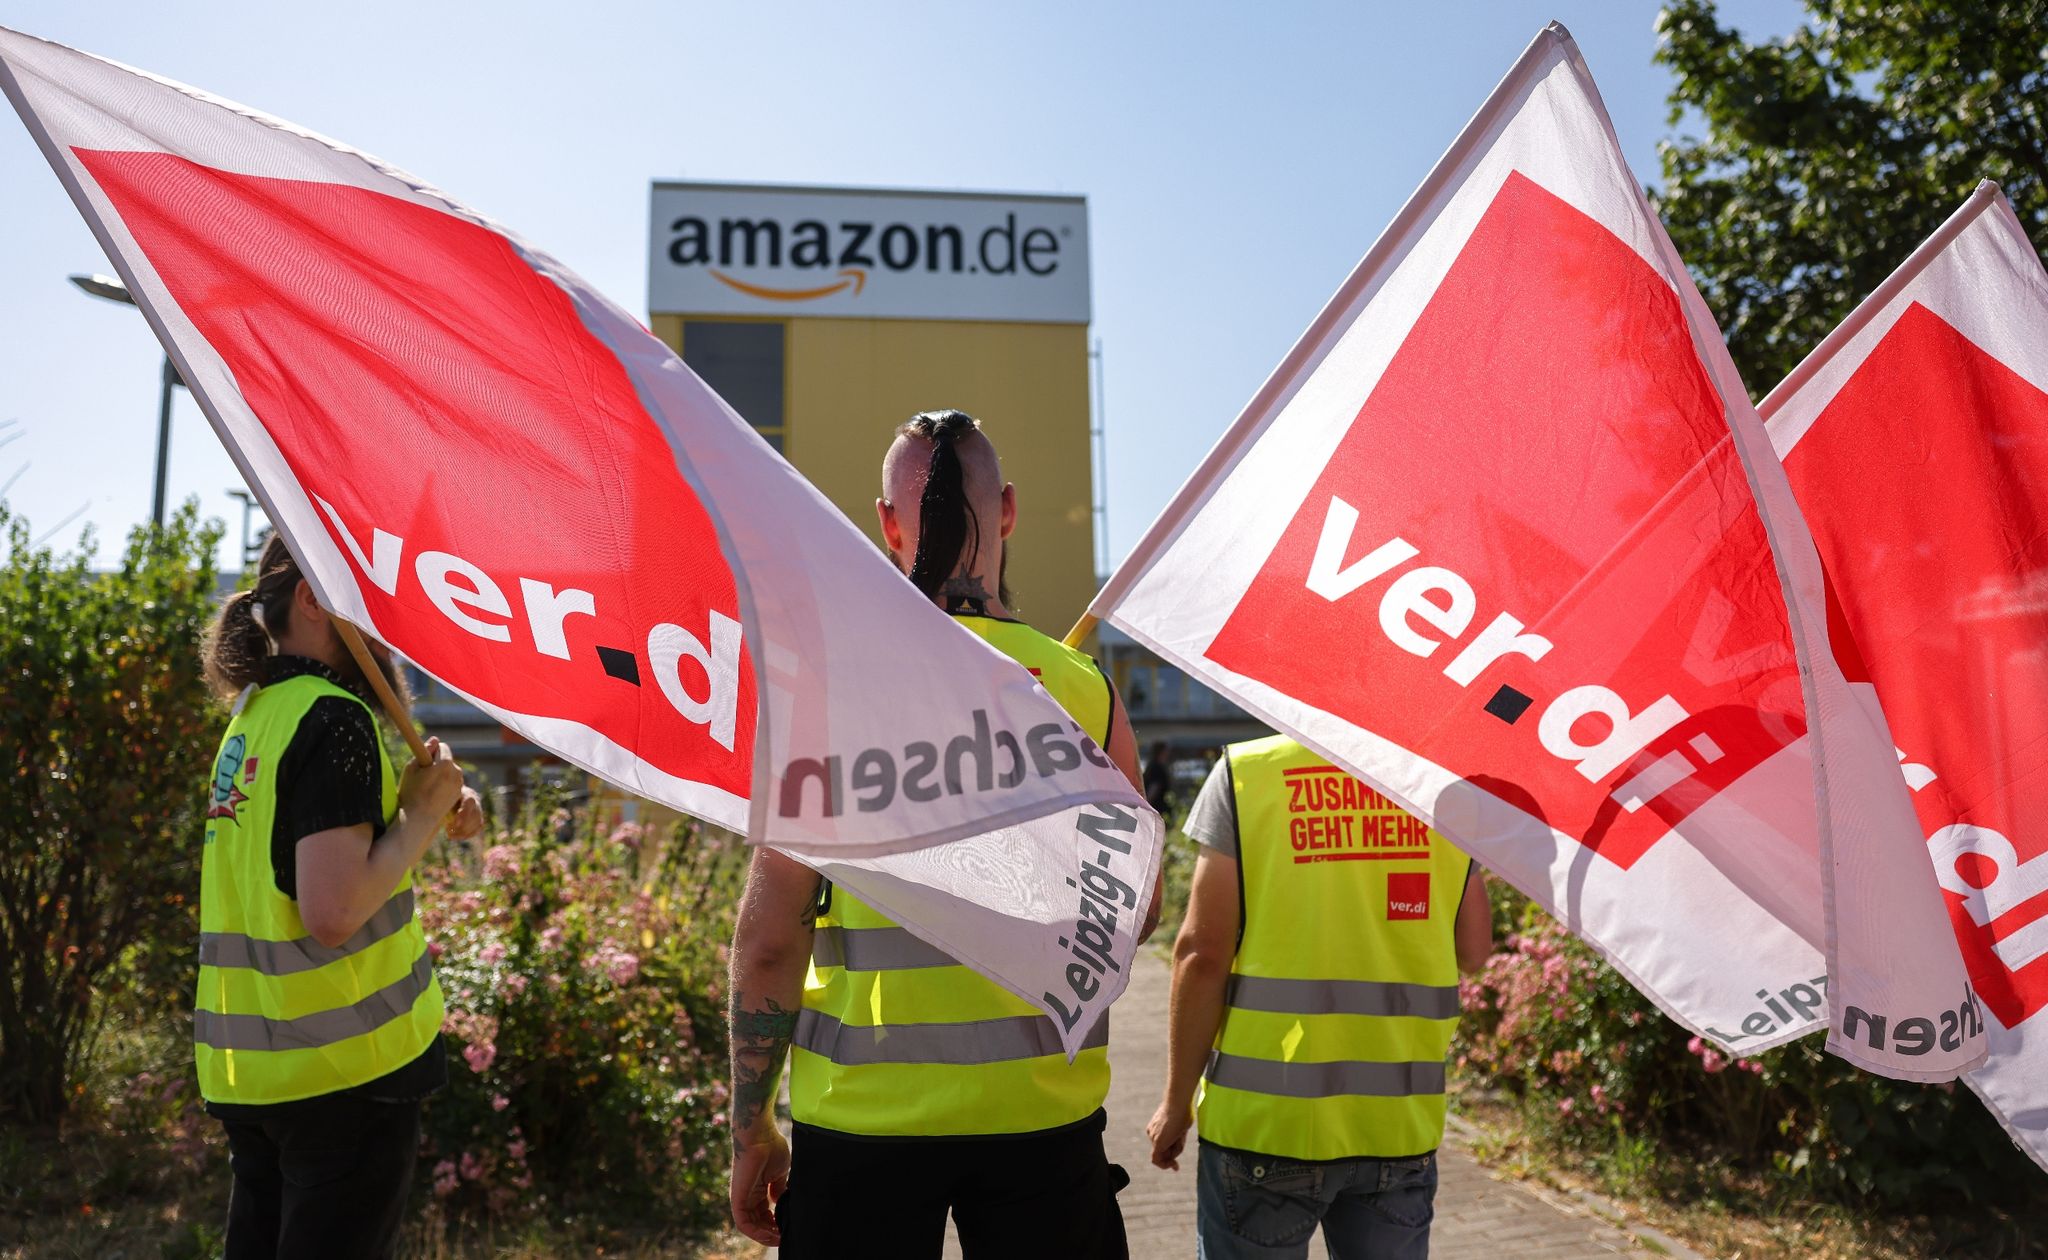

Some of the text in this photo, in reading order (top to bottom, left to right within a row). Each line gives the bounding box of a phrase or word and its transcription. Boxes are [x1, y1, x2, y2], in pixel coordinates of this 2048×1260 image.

[668, 212, 1060, 277] amazon.de
[1305, 494, 1726, 814] ver.di
[1289, 815, 1430, 851] GEHT MEHR
[1390, 901, 1426, 914] ver.di
